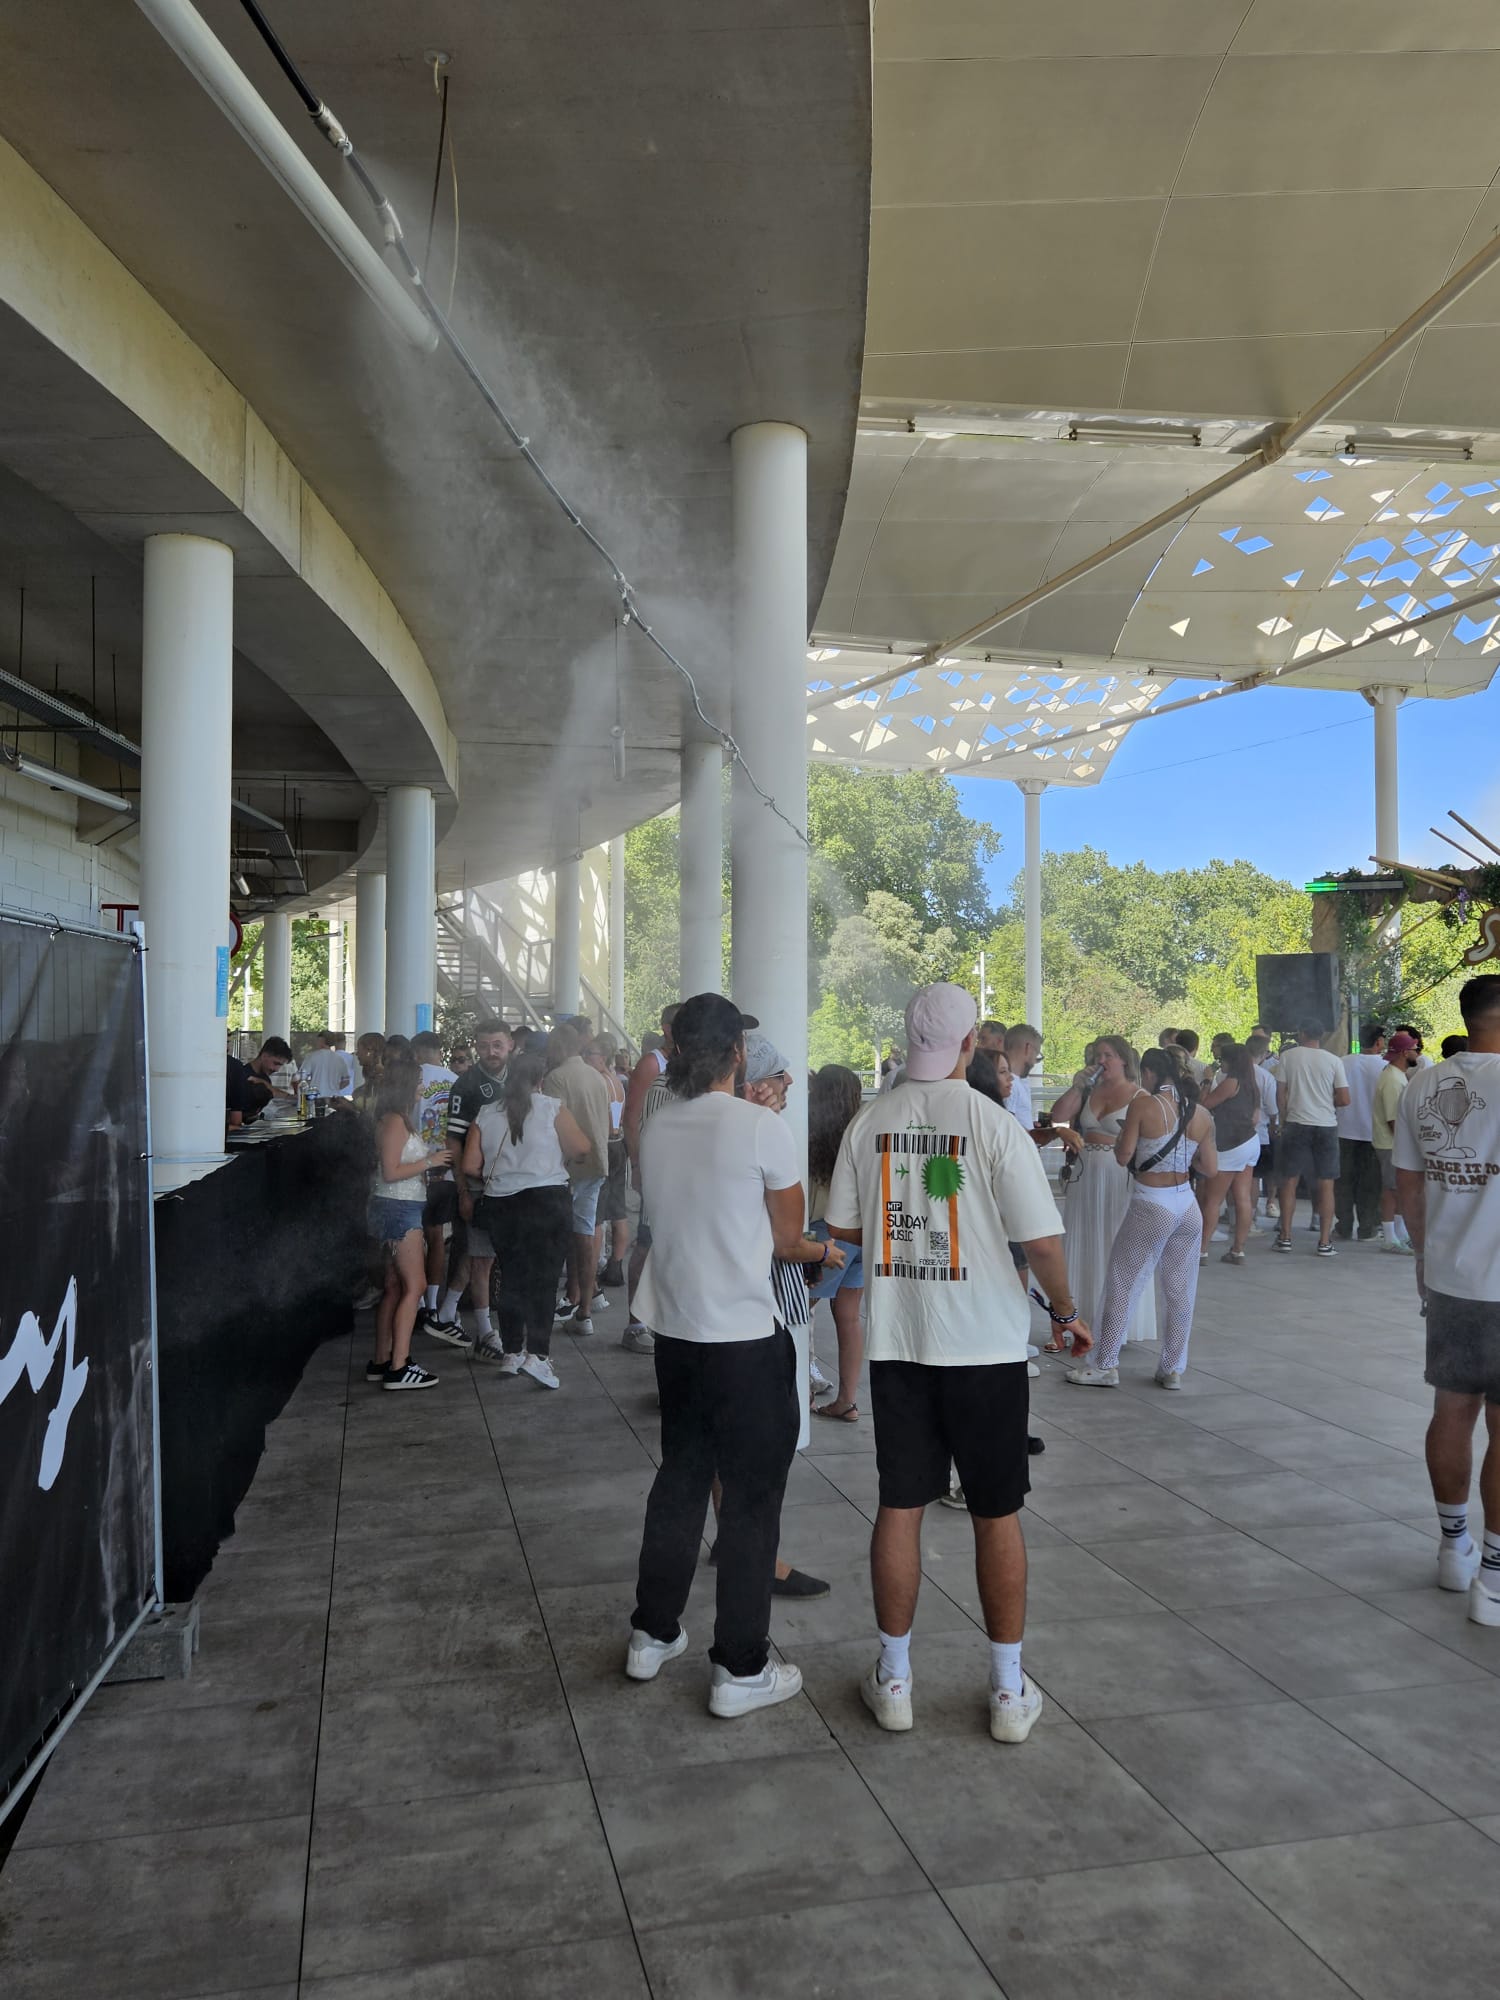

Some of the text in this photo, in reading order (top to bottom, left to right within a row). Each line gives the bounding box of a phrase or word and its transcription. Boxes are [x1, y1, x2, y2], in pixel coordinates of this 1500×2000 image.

[1424, 1159, 1500, 1176] ARGE IT TO
[886, 1214, 928, 1230] SUNDAY
[886, 1229, 914, 1242] MUSIC
